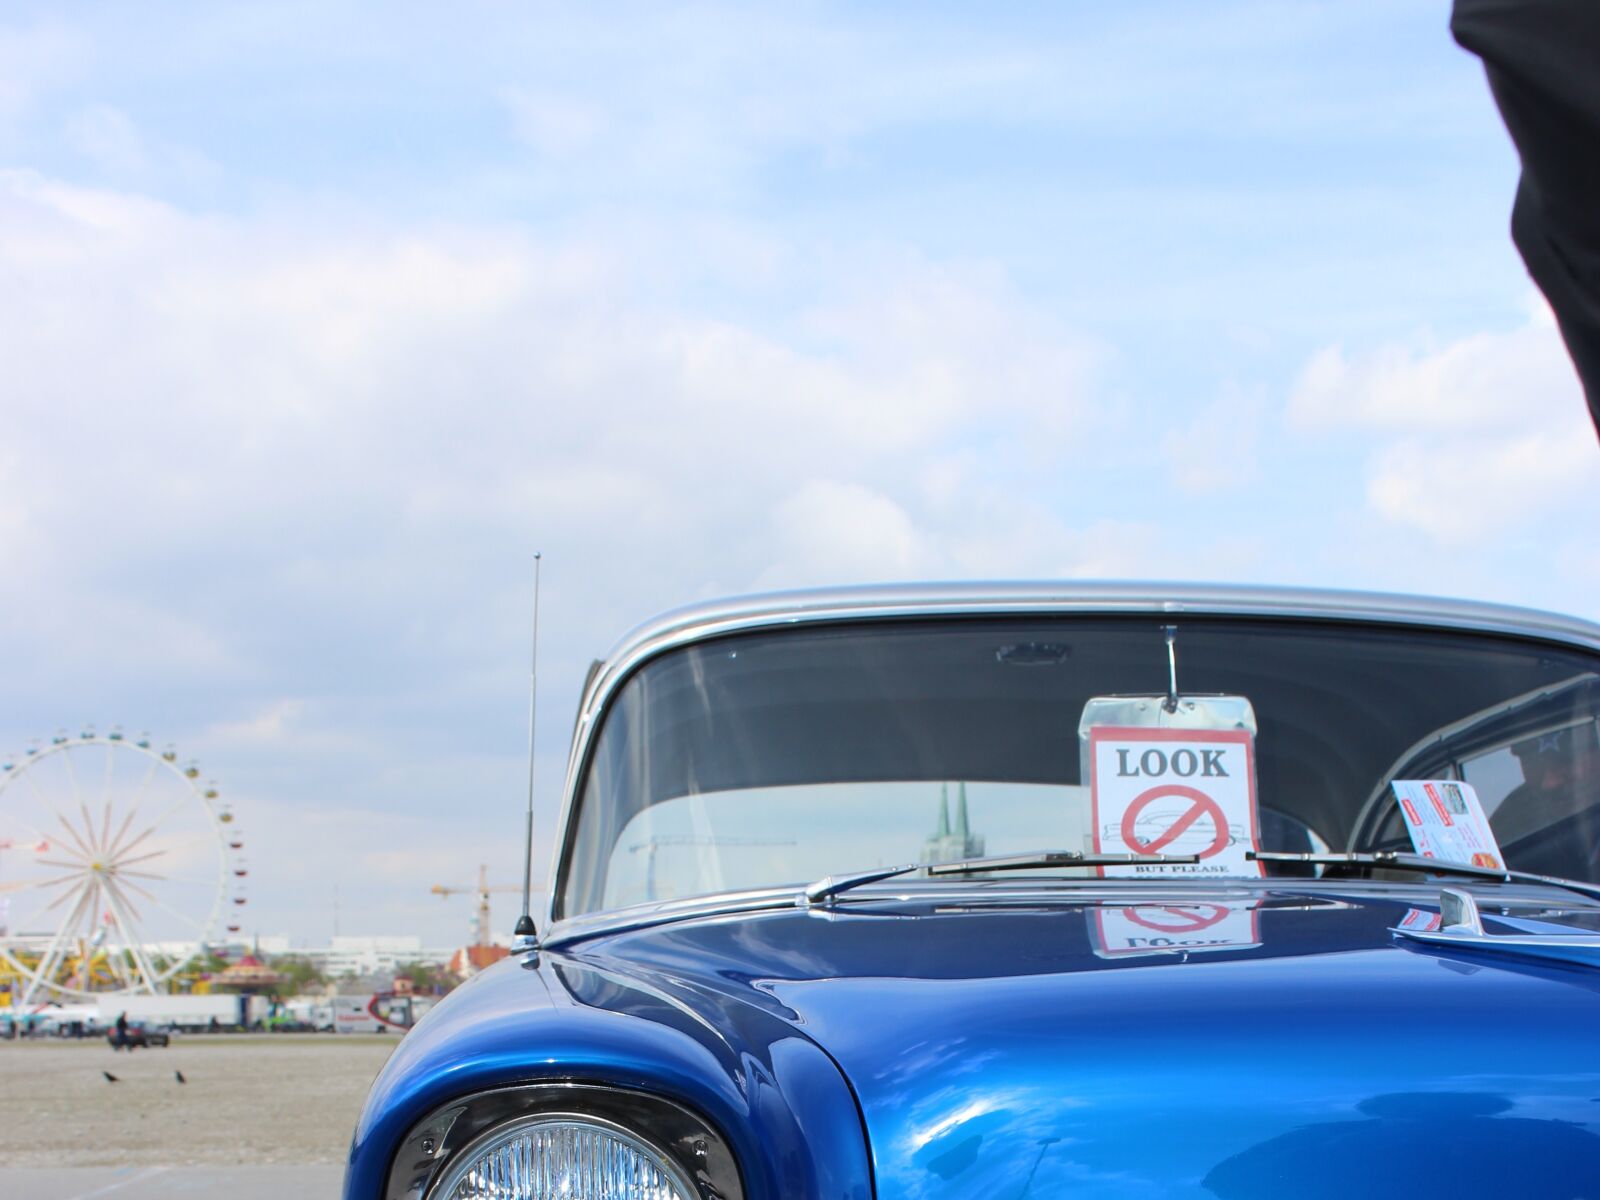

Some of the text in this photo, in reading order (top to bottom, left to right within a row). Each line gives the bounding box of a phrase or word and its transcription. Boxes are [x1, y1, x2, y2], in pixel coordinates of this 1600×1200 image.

[1116, 749, 1229, 777] LOOK
[1136, 865, 1229, 873] BUT PLEASE
